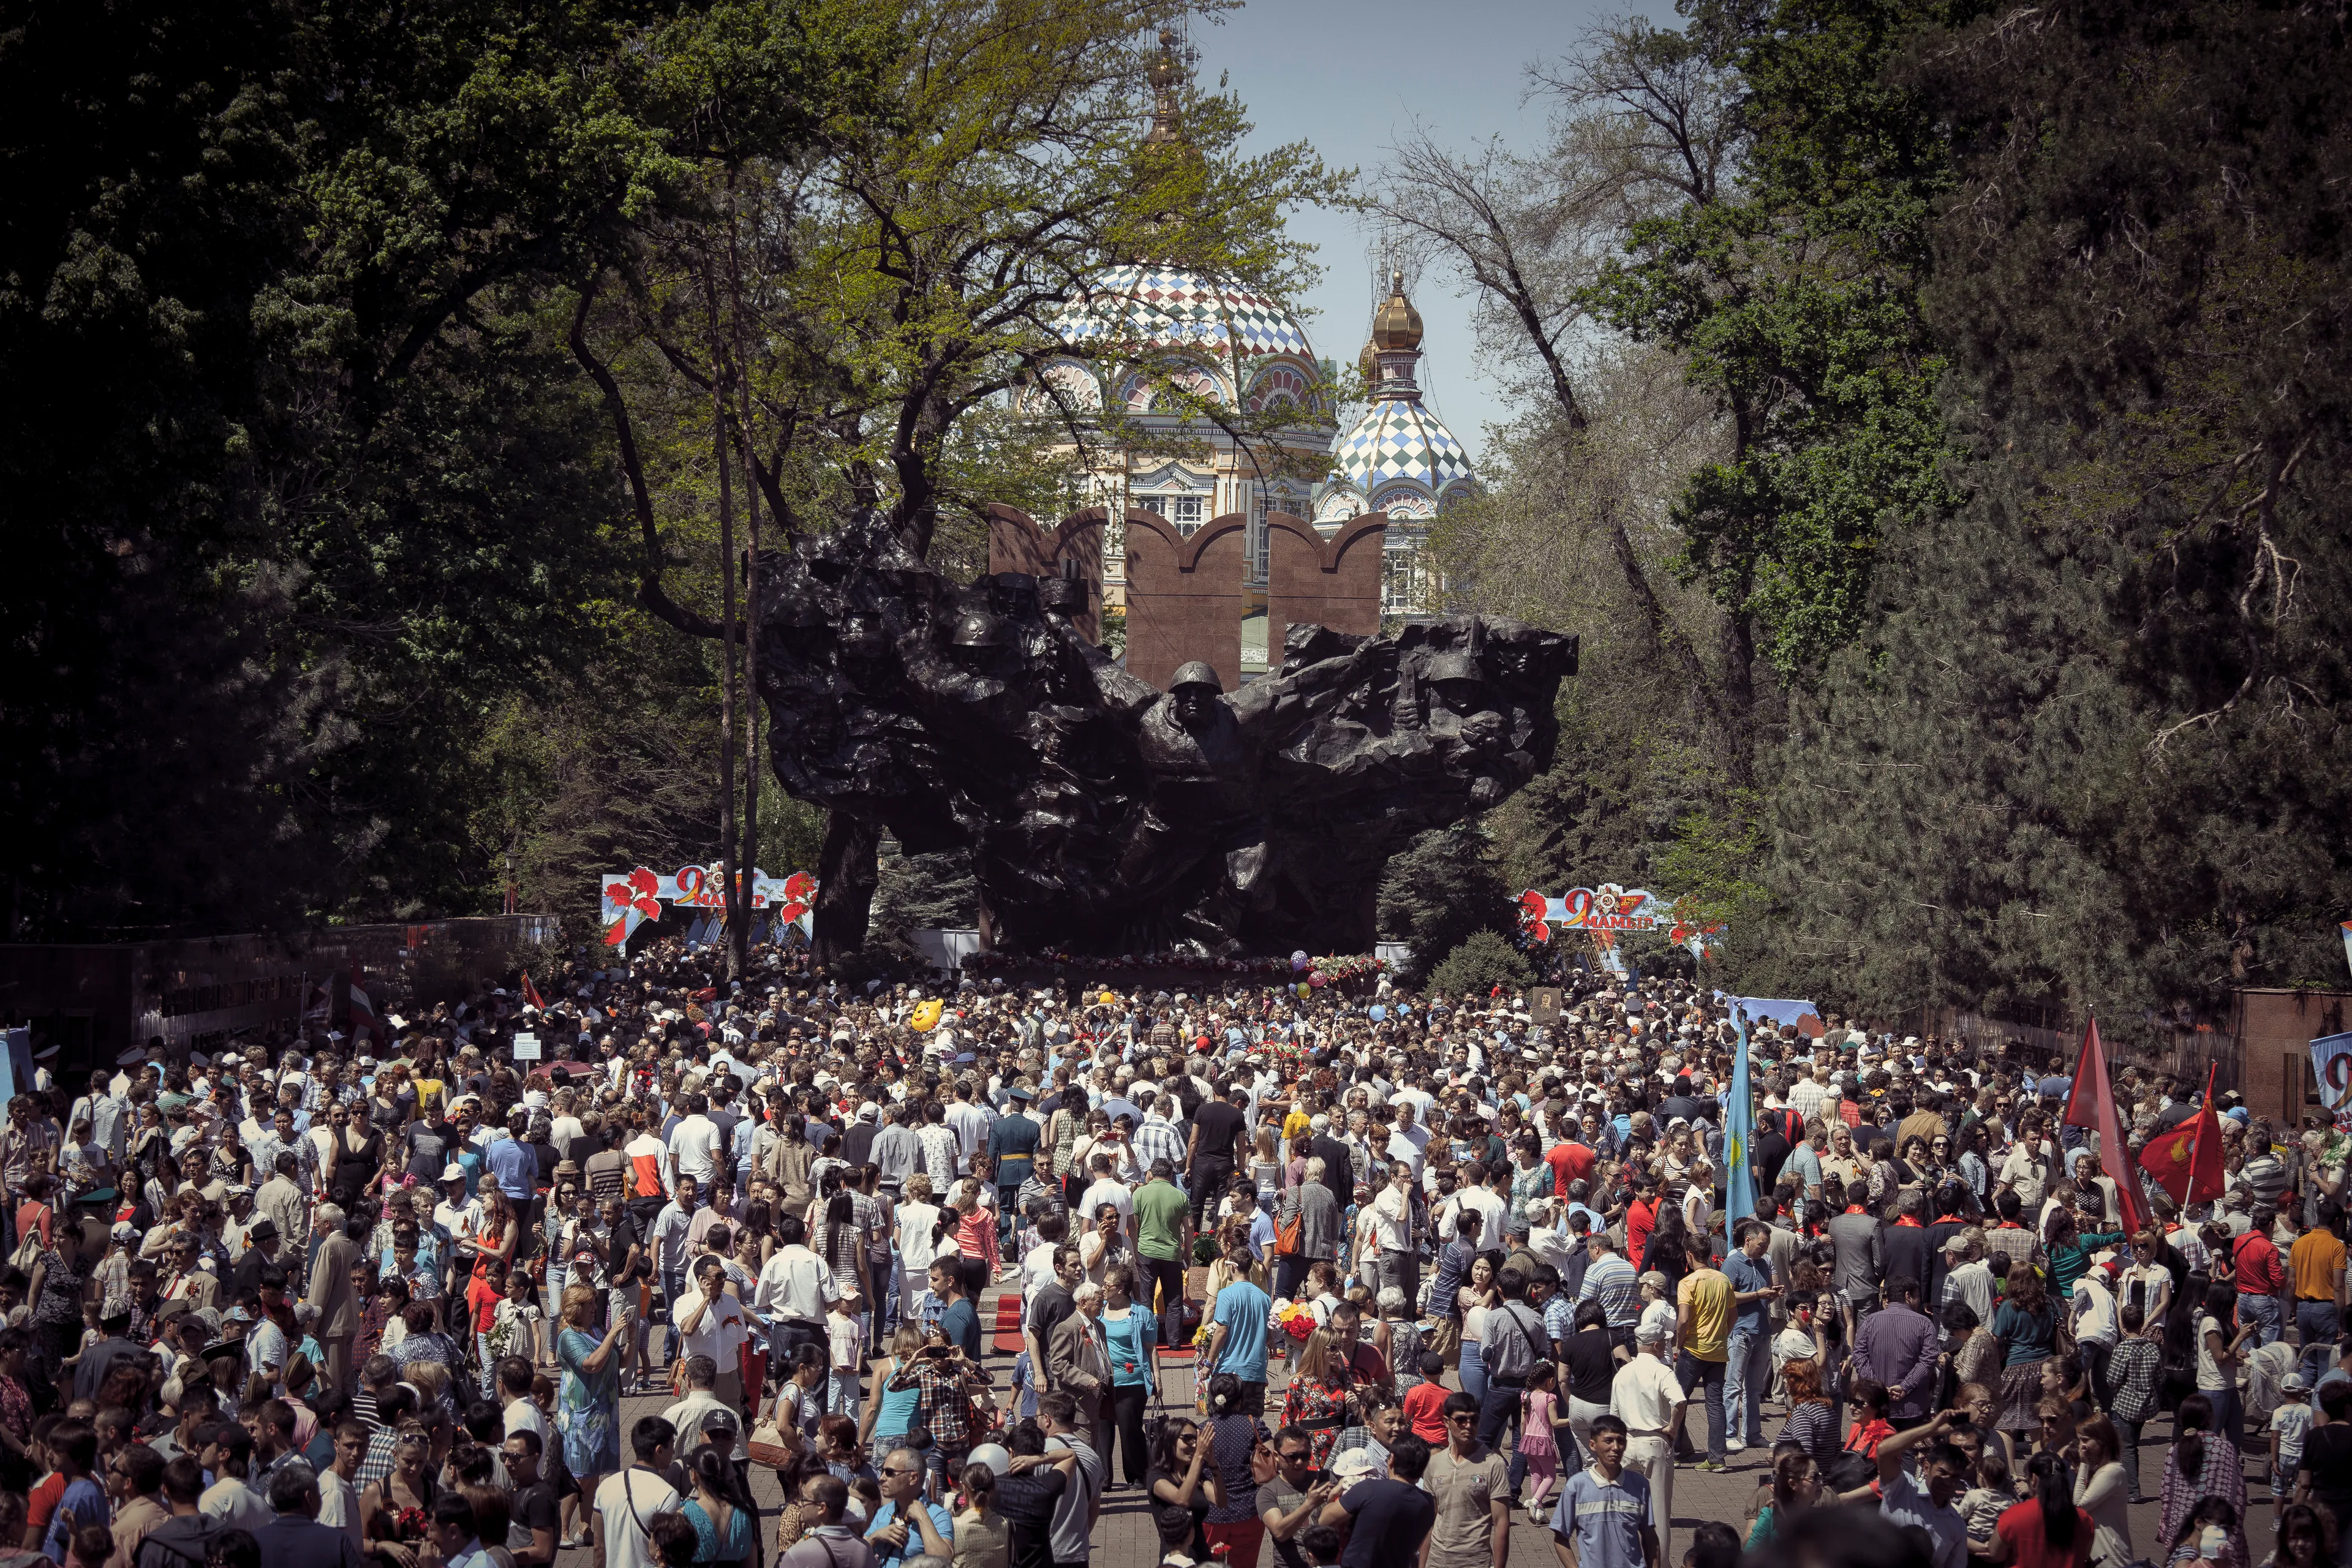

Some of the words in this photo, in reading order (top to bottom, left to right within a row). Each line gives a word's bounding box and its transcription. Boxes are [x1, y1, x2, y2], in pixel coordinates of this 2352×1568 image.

[674, 867, 704, 904] 9
[693, 893, 765, 908] МАР
[1562, 889, 1593, 926] 9
[1581, 915, 1654, 930] МАМЫР
